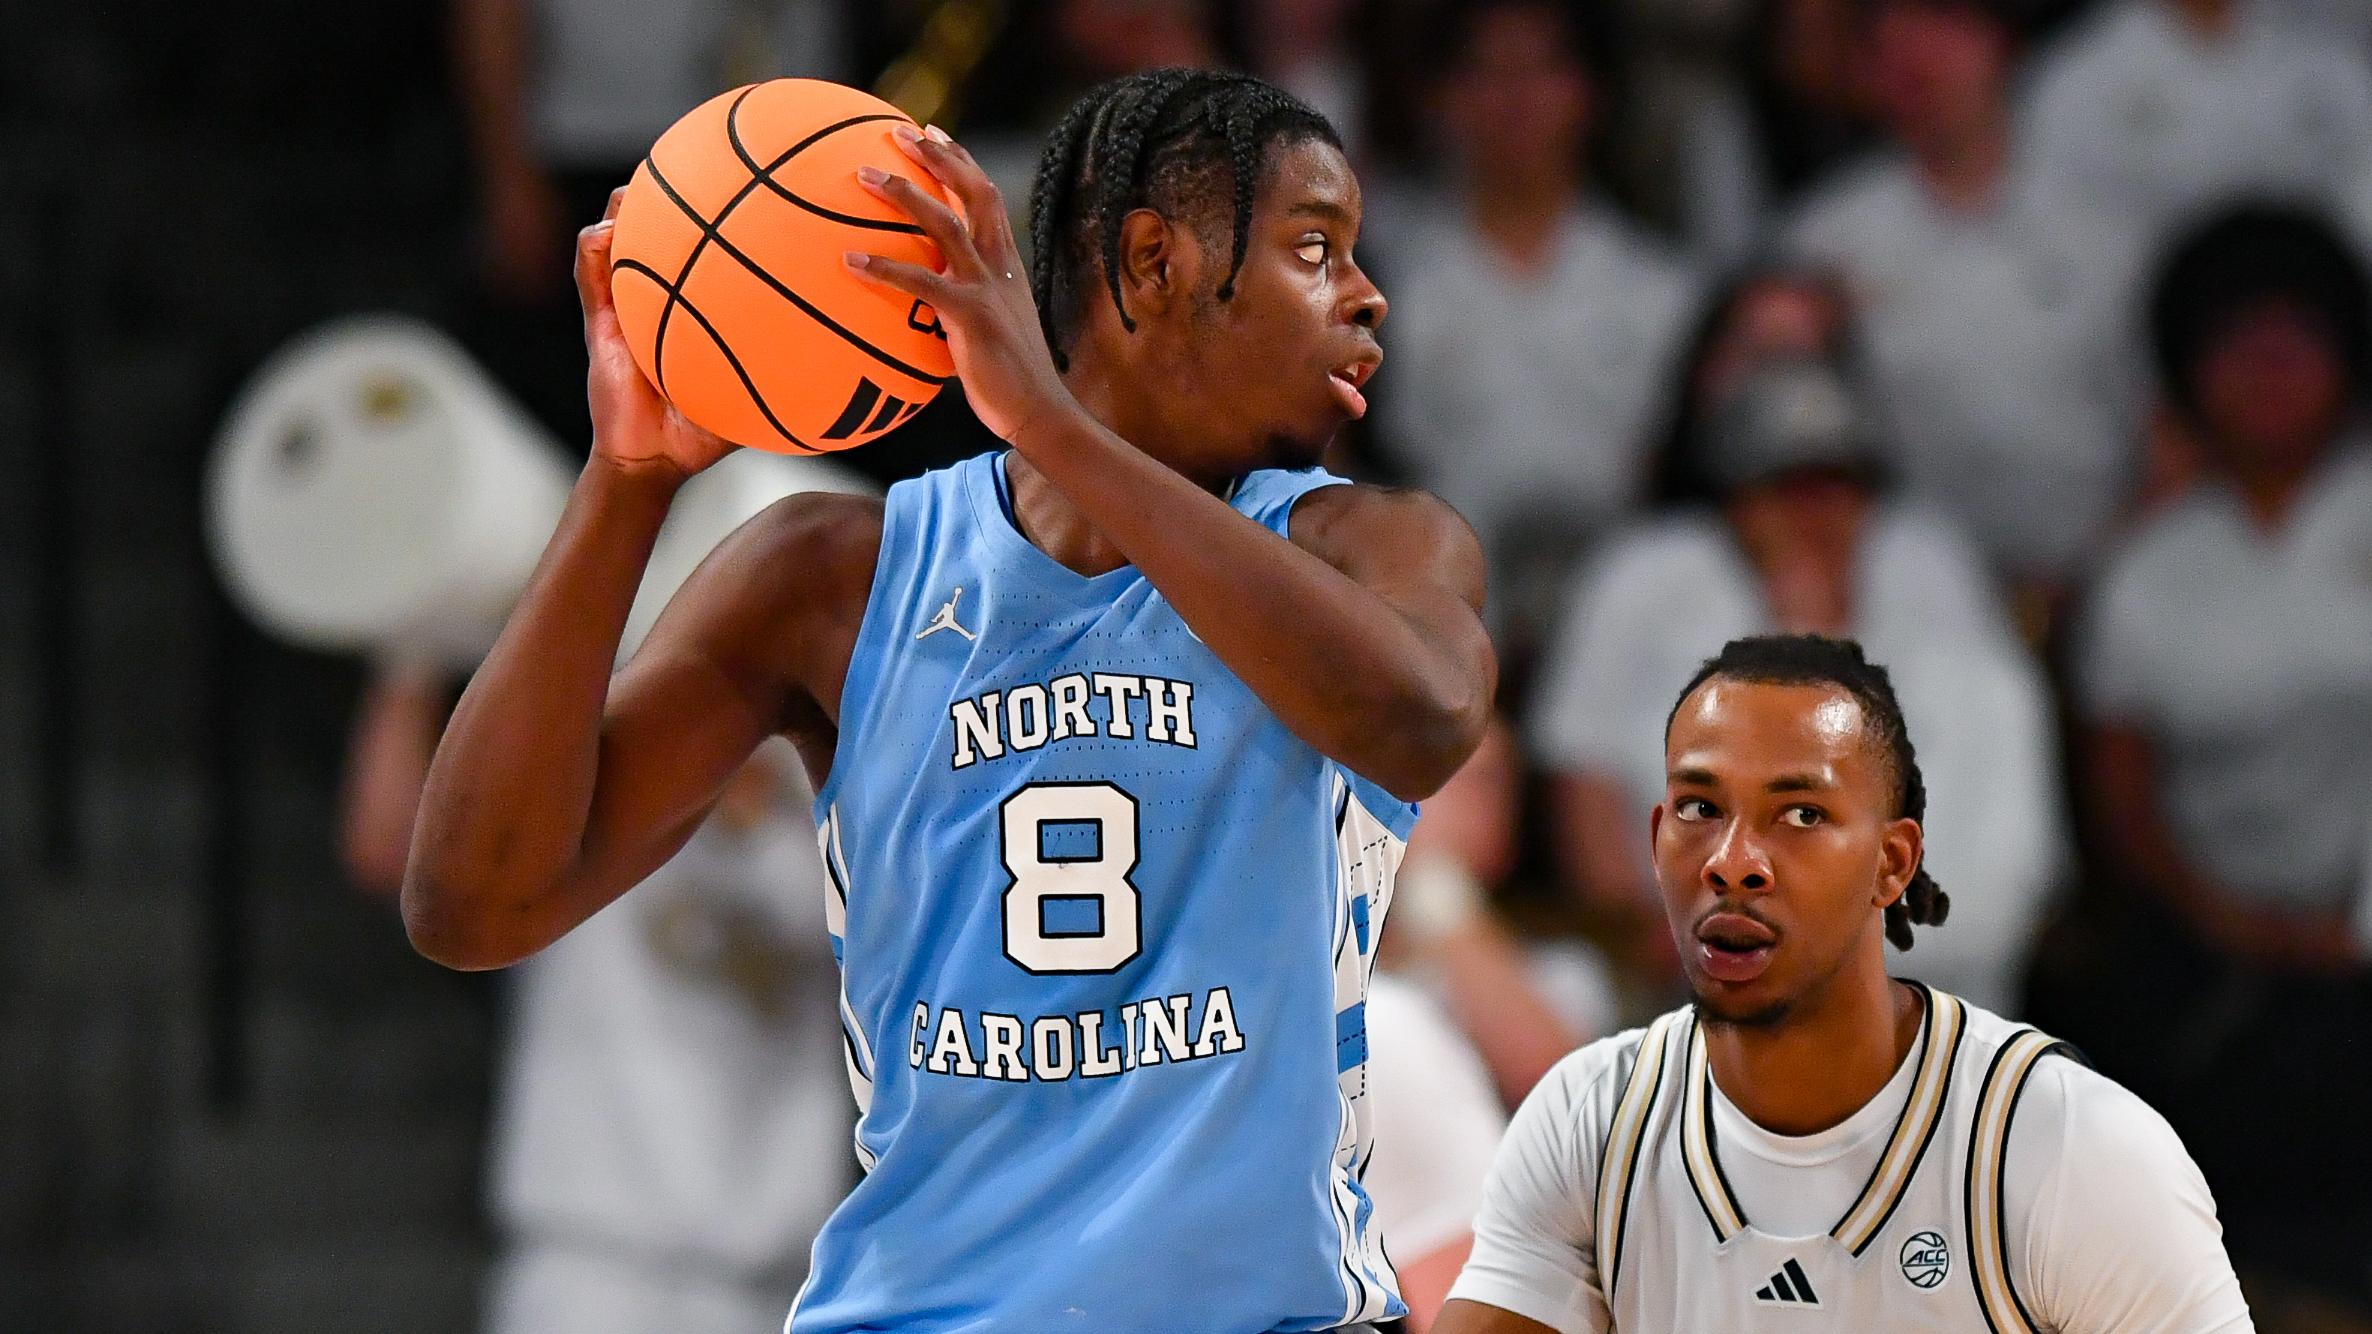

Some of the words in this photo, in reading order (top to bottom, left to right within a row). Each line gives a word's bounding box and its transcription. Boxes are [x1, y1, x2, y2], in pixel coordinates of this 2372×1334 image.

[950, 672, 1198, 771] NORTH
[1000, 780, 1143, 976] 8
[908, 986, 1246, 1083] CAROLINA
[1903, 1248, 1947, 1266] ACC
